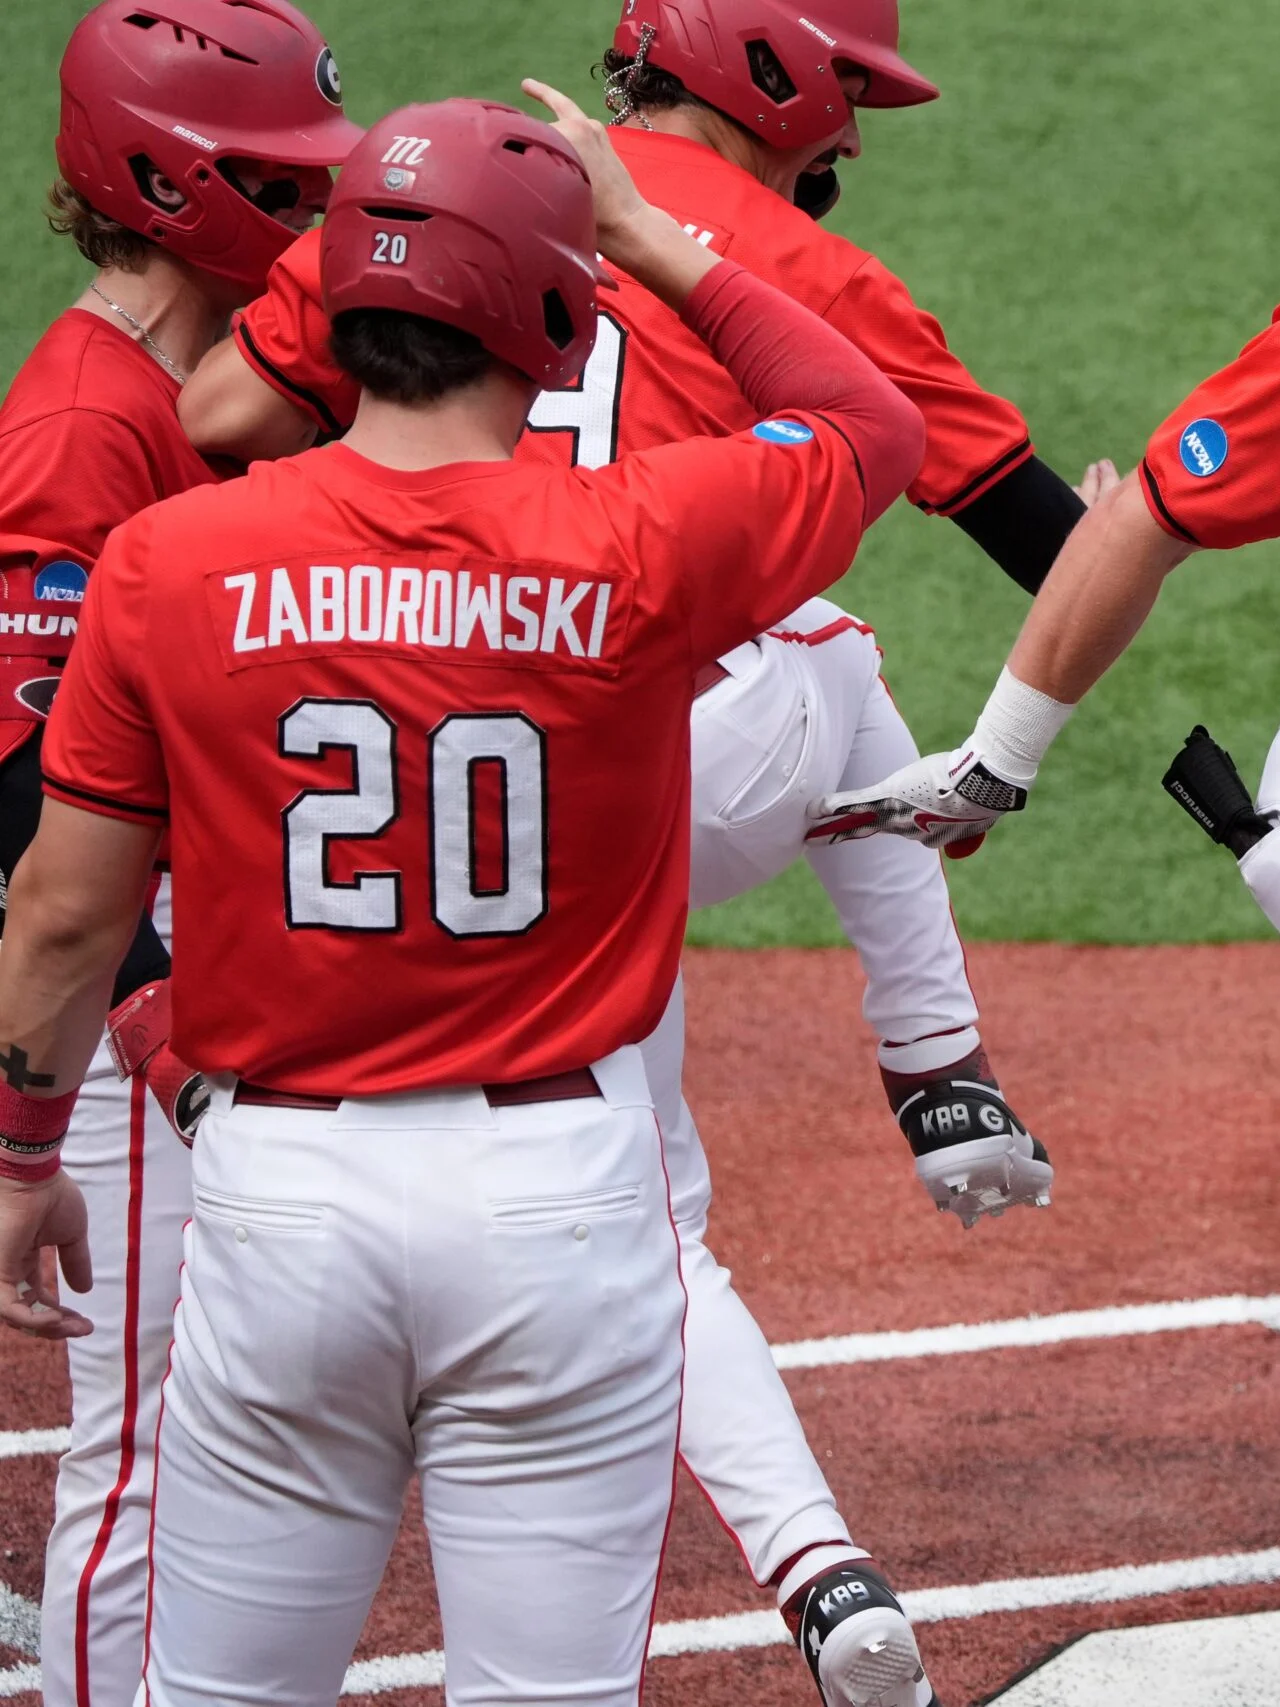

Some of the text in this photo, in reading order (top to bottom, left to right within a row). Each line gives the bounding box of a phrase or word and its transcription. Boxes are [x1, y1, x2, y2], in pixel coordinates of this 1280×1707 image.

[798, 17, 838, 48] marucci
[172, 124, 218, 151] marucci
[371, 231, 407, 264] 20
[1184, 431, 1214, 476] NCAA
[40, 585, 84, 601] NCAA
[223, 565, 612, 658] ZABOROWSKI
[276, 695, 551, 939] 20
[1170, 780, 1215, 829] marucci
[921, 1103, 971, 1136] KB9
[8, 1143, 40, 1153] EVERY
[818, 1581, 871, 1617] KB9
